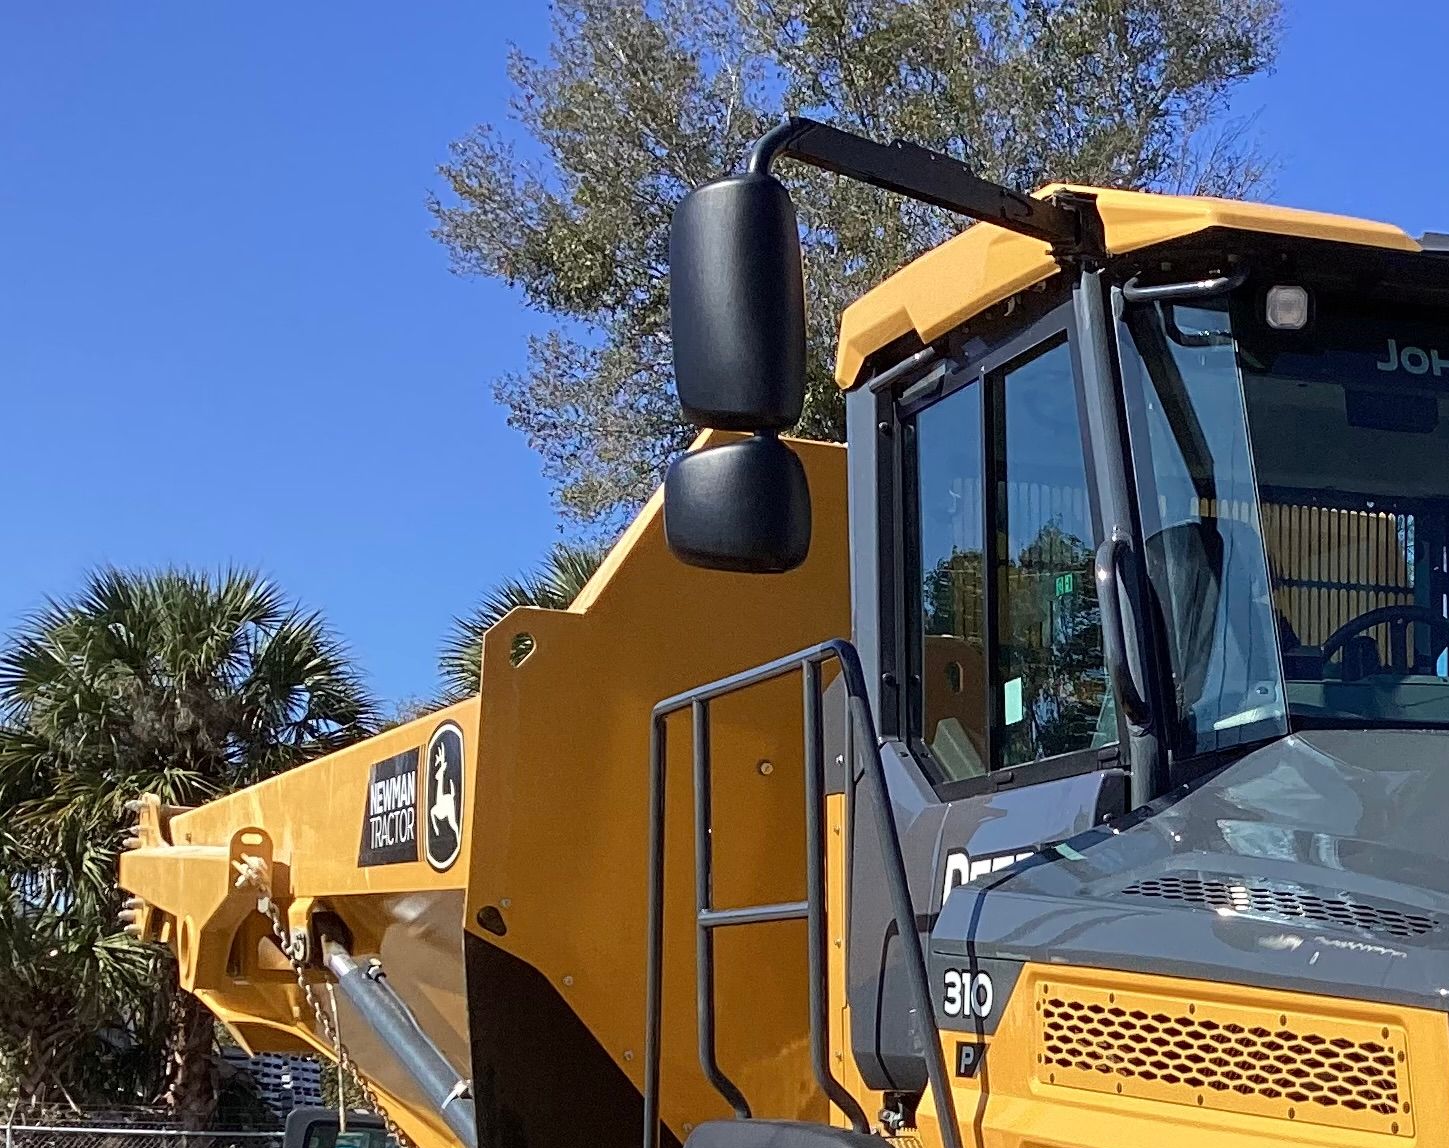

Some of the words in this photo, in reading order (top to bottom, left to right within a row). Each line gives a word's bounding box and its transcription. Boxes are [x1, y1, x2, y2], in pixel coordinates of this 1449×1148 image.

[370, 771, 416, 816] NEWMAN
[370, 807, 415, 849] TRACTOR
[944, 970, 993, 1018] 310
